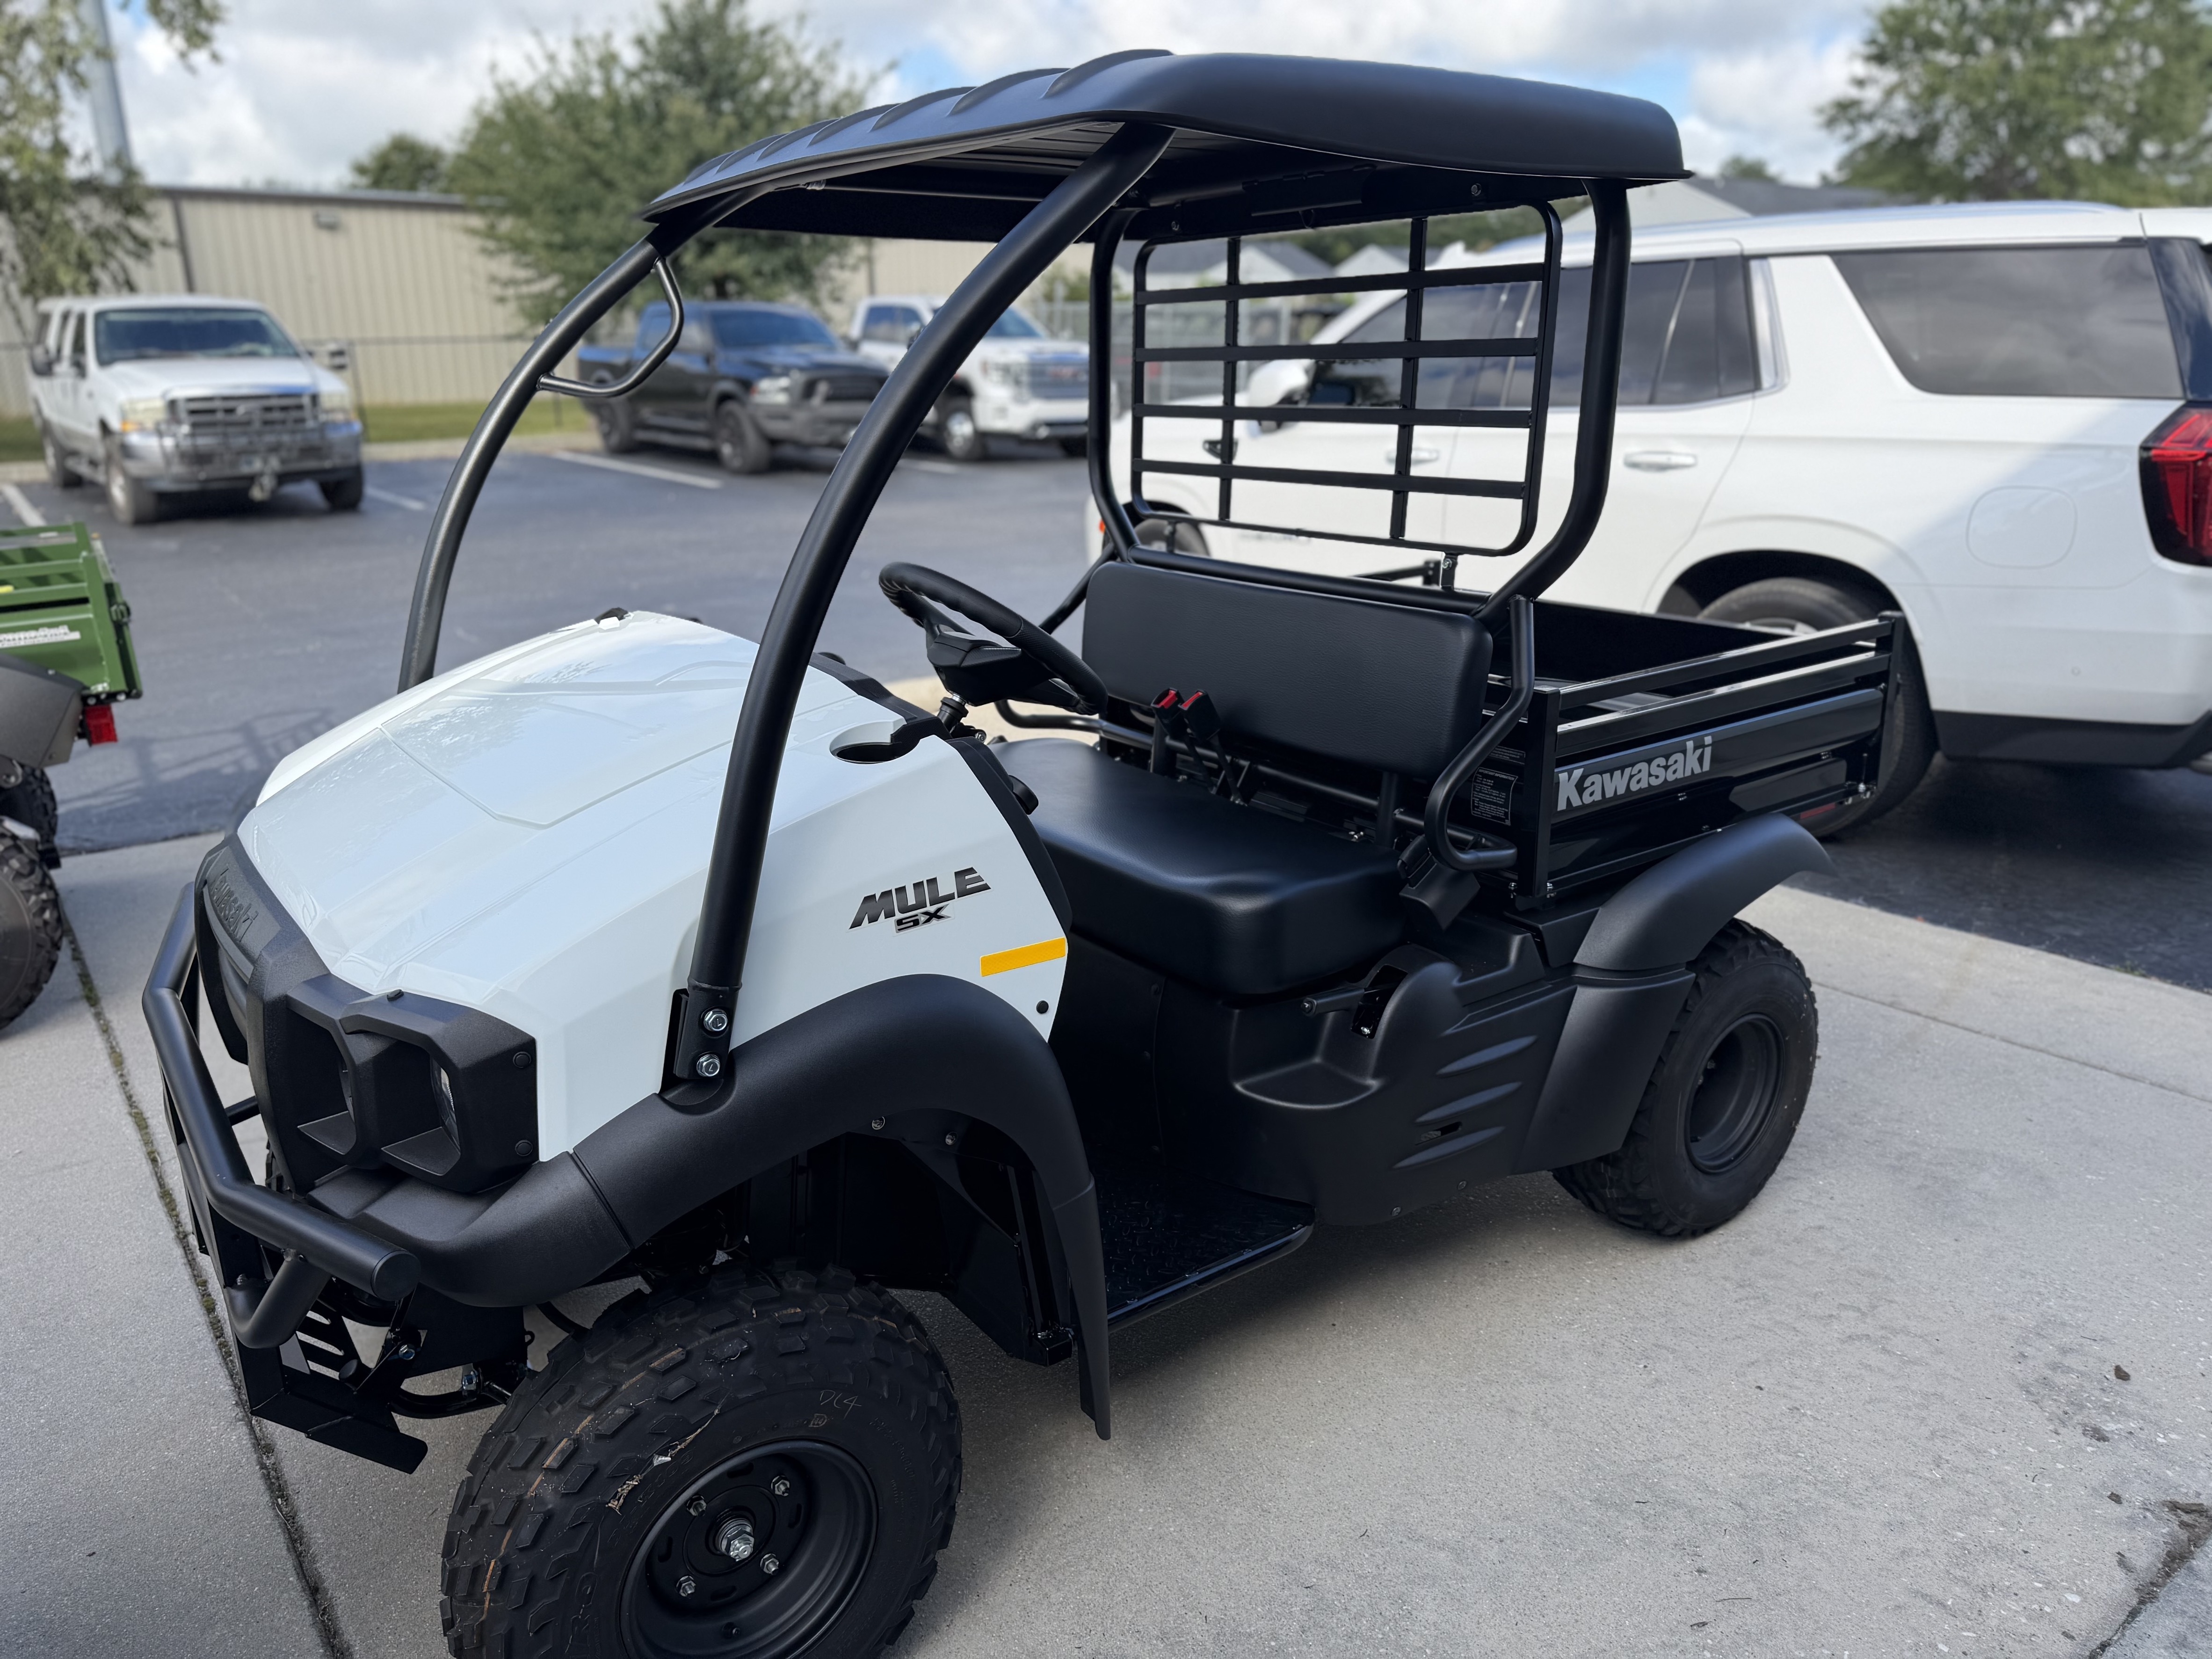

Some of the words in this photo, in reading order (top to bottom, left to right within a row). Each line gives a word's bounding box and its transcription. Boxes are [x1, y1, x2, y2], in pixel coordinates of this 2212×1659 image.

[1557, 736, 1712, 811] Kawasaki
[849, 867, 991, 929] MULE
[895, 904, 952, 933] SX
